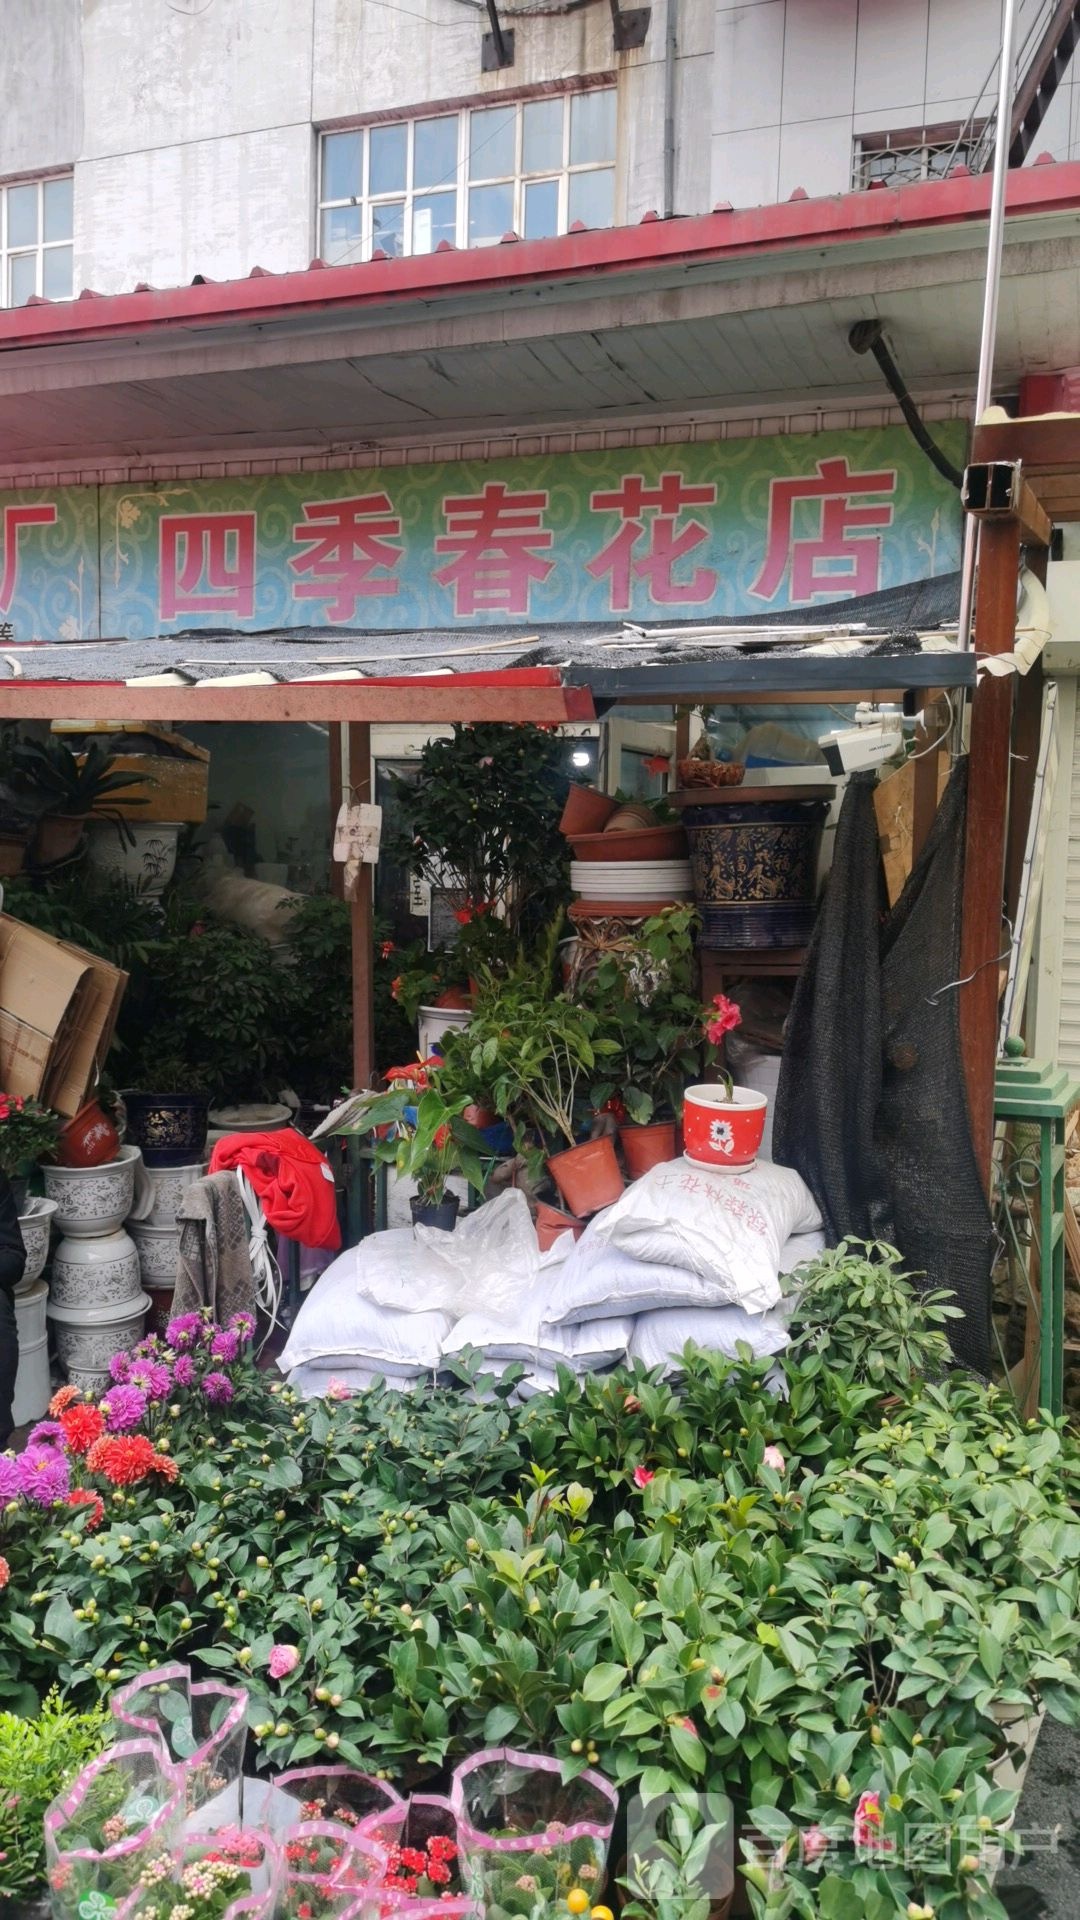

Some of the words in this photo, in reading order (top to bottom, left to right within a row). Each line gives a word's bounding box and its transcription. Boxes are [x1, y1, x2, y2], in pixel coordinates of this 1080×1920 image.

[158, 456, 898, 622] 四季春花店
